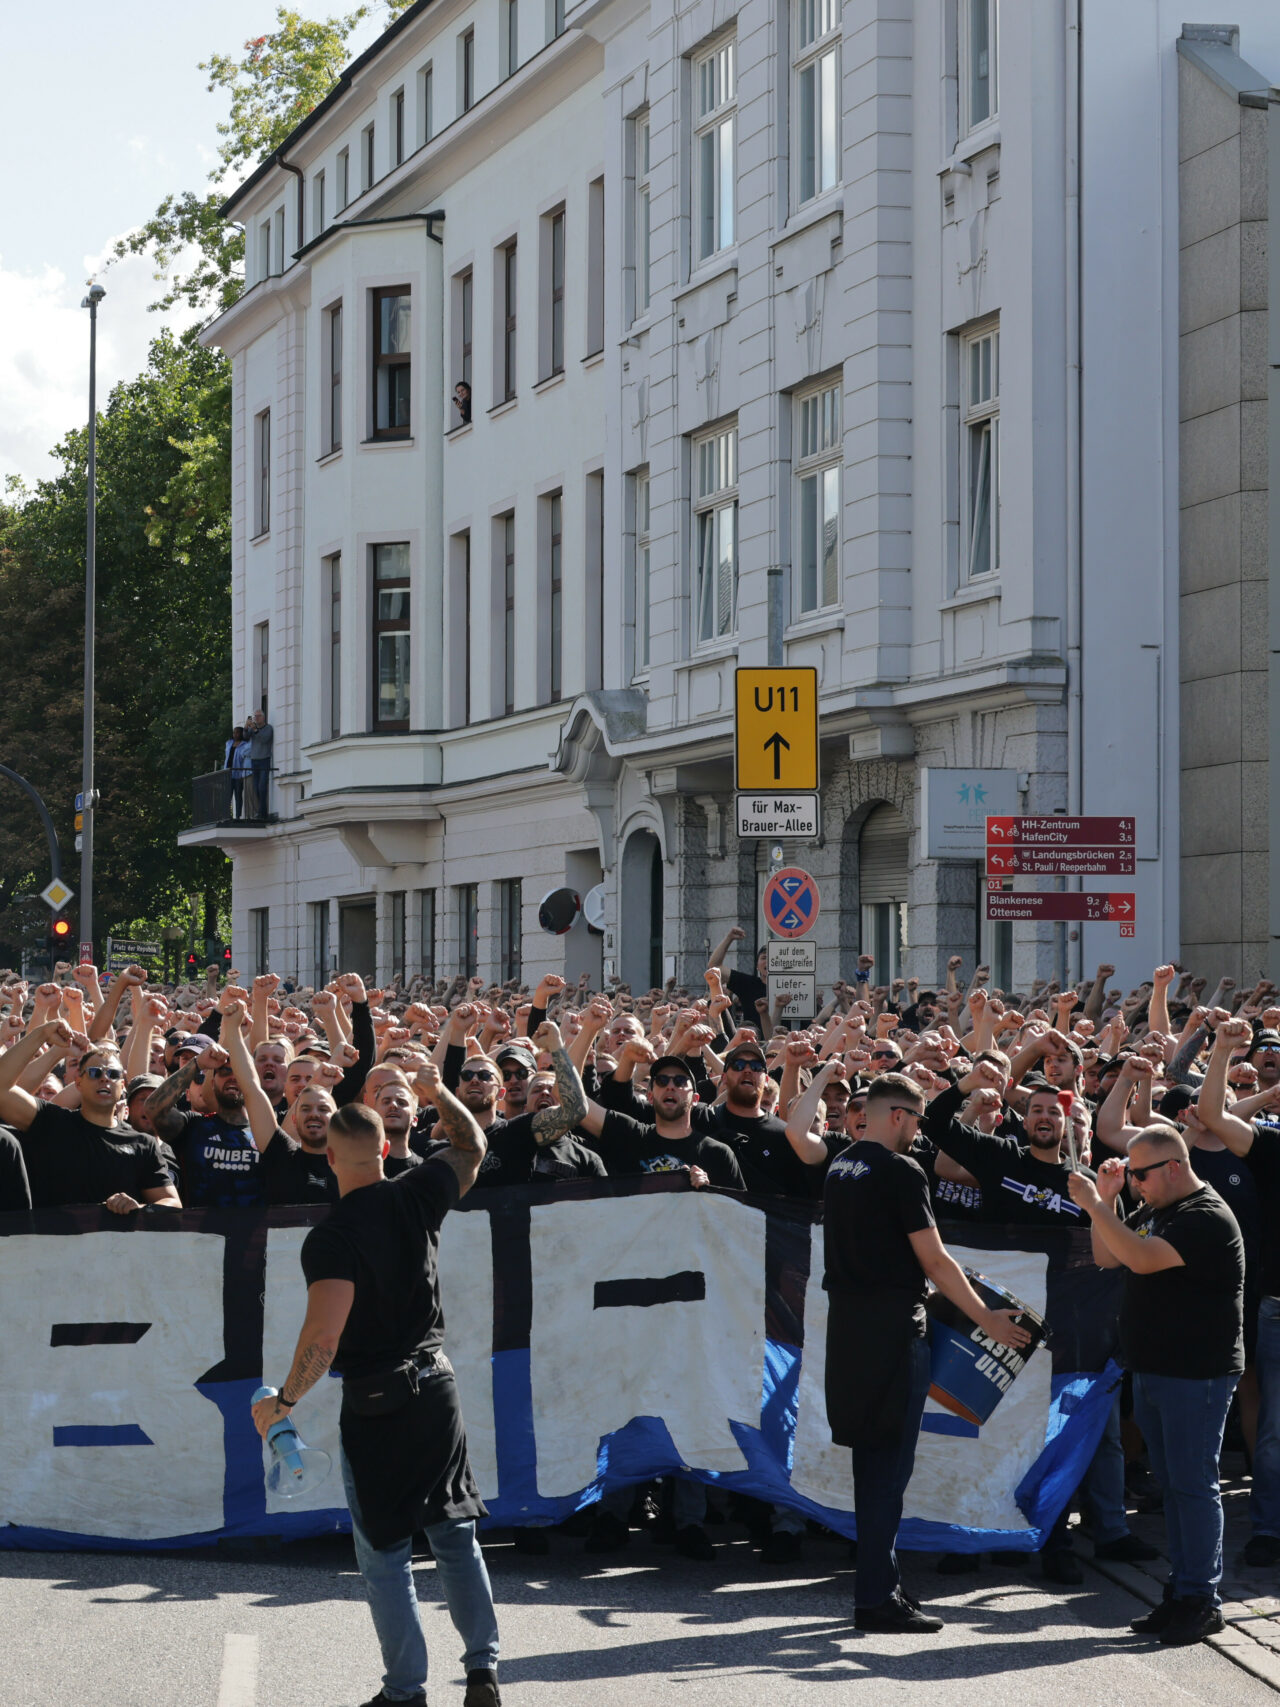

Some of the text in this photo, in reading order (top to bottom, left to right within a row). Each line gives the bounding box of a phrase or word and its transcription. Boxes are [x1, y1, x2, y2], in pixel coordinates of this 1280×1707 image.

[754, 686, 799, 712] U11
[751, 800, 803, 813] für Max-
[742, 819, 813, 832] Brauer-Allee
[1021, 820, 1132, 830] HH-Zentrum 4,1
[1021, 832, 1132, 843] HafenCity 3,5
[1032, 850, 1132, 861] Landungsbrücken 2,5
[1022, 862, 1032, 872] St.
[1034, 862, 1054, 872] Pauli
[1060, 862, 1107, 873] Reeperbahn
[1119, 862, 1132, 872] 1,3
[987, 880, 1002, 890] 01
[989, 895, 1100, 906] Blankenese 9,2
[989, 907, 1100, 918] Ottensen 1,0
[1120, 926, 1134, 936] 01
[778, 947, 806, 956] auf dem
[770, 958, 813, 968] Seitenstreifen
[776, 979, 807, 989] Liefer-
[203, 1146, 260, 1164] UNIBET
